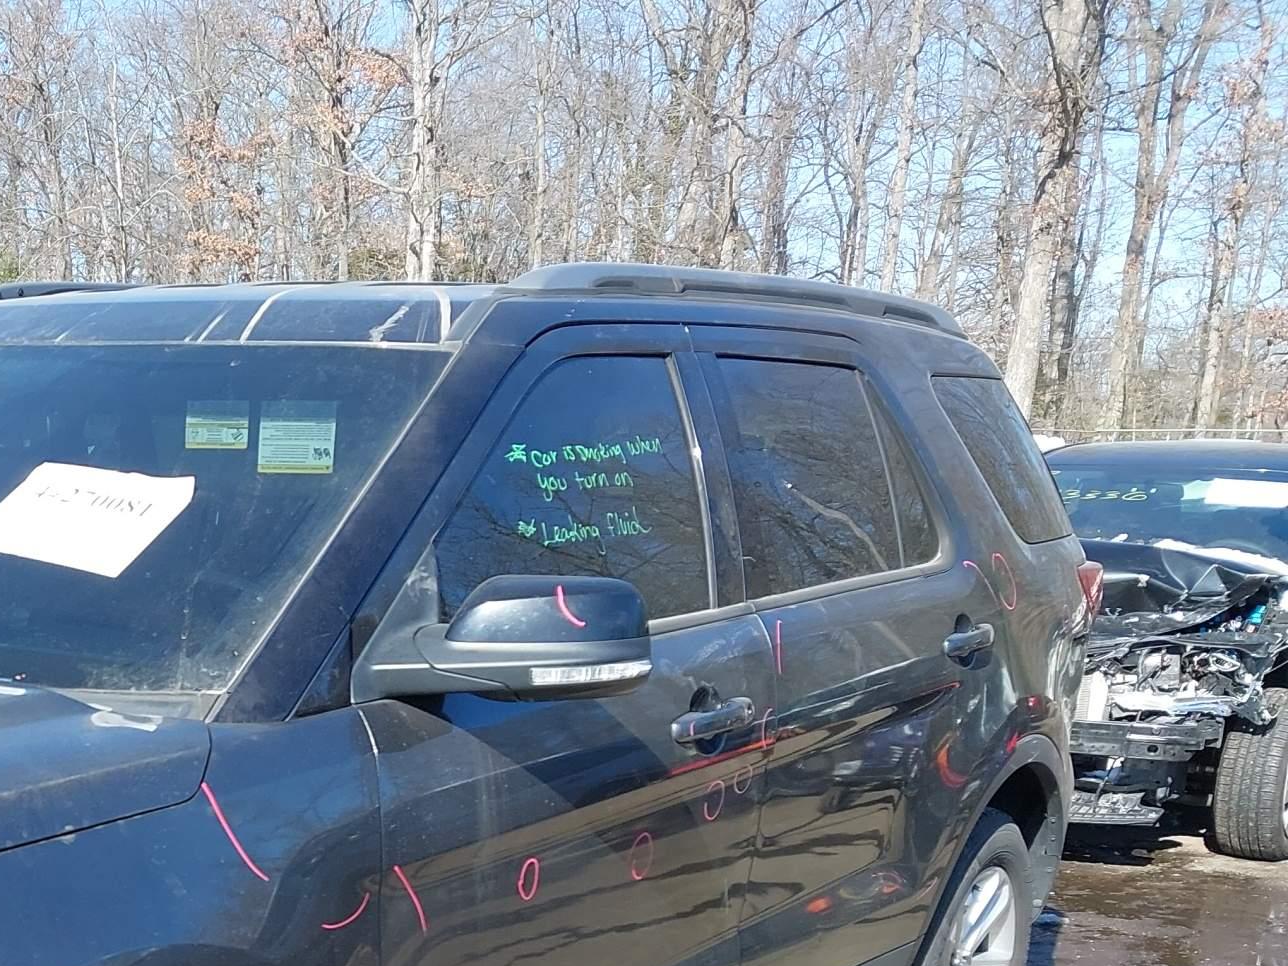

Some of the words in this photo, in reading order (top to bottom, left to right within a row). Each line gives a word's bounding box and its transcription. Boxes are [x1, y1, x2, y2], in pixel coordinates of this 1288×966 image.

[626, 435, 663, 456] when
[537, 472, 568, 502] you
[575, 471, 610, 491] turn
[614, 471, 634, 487] on
[541, 514, 607, 556] Leaking
